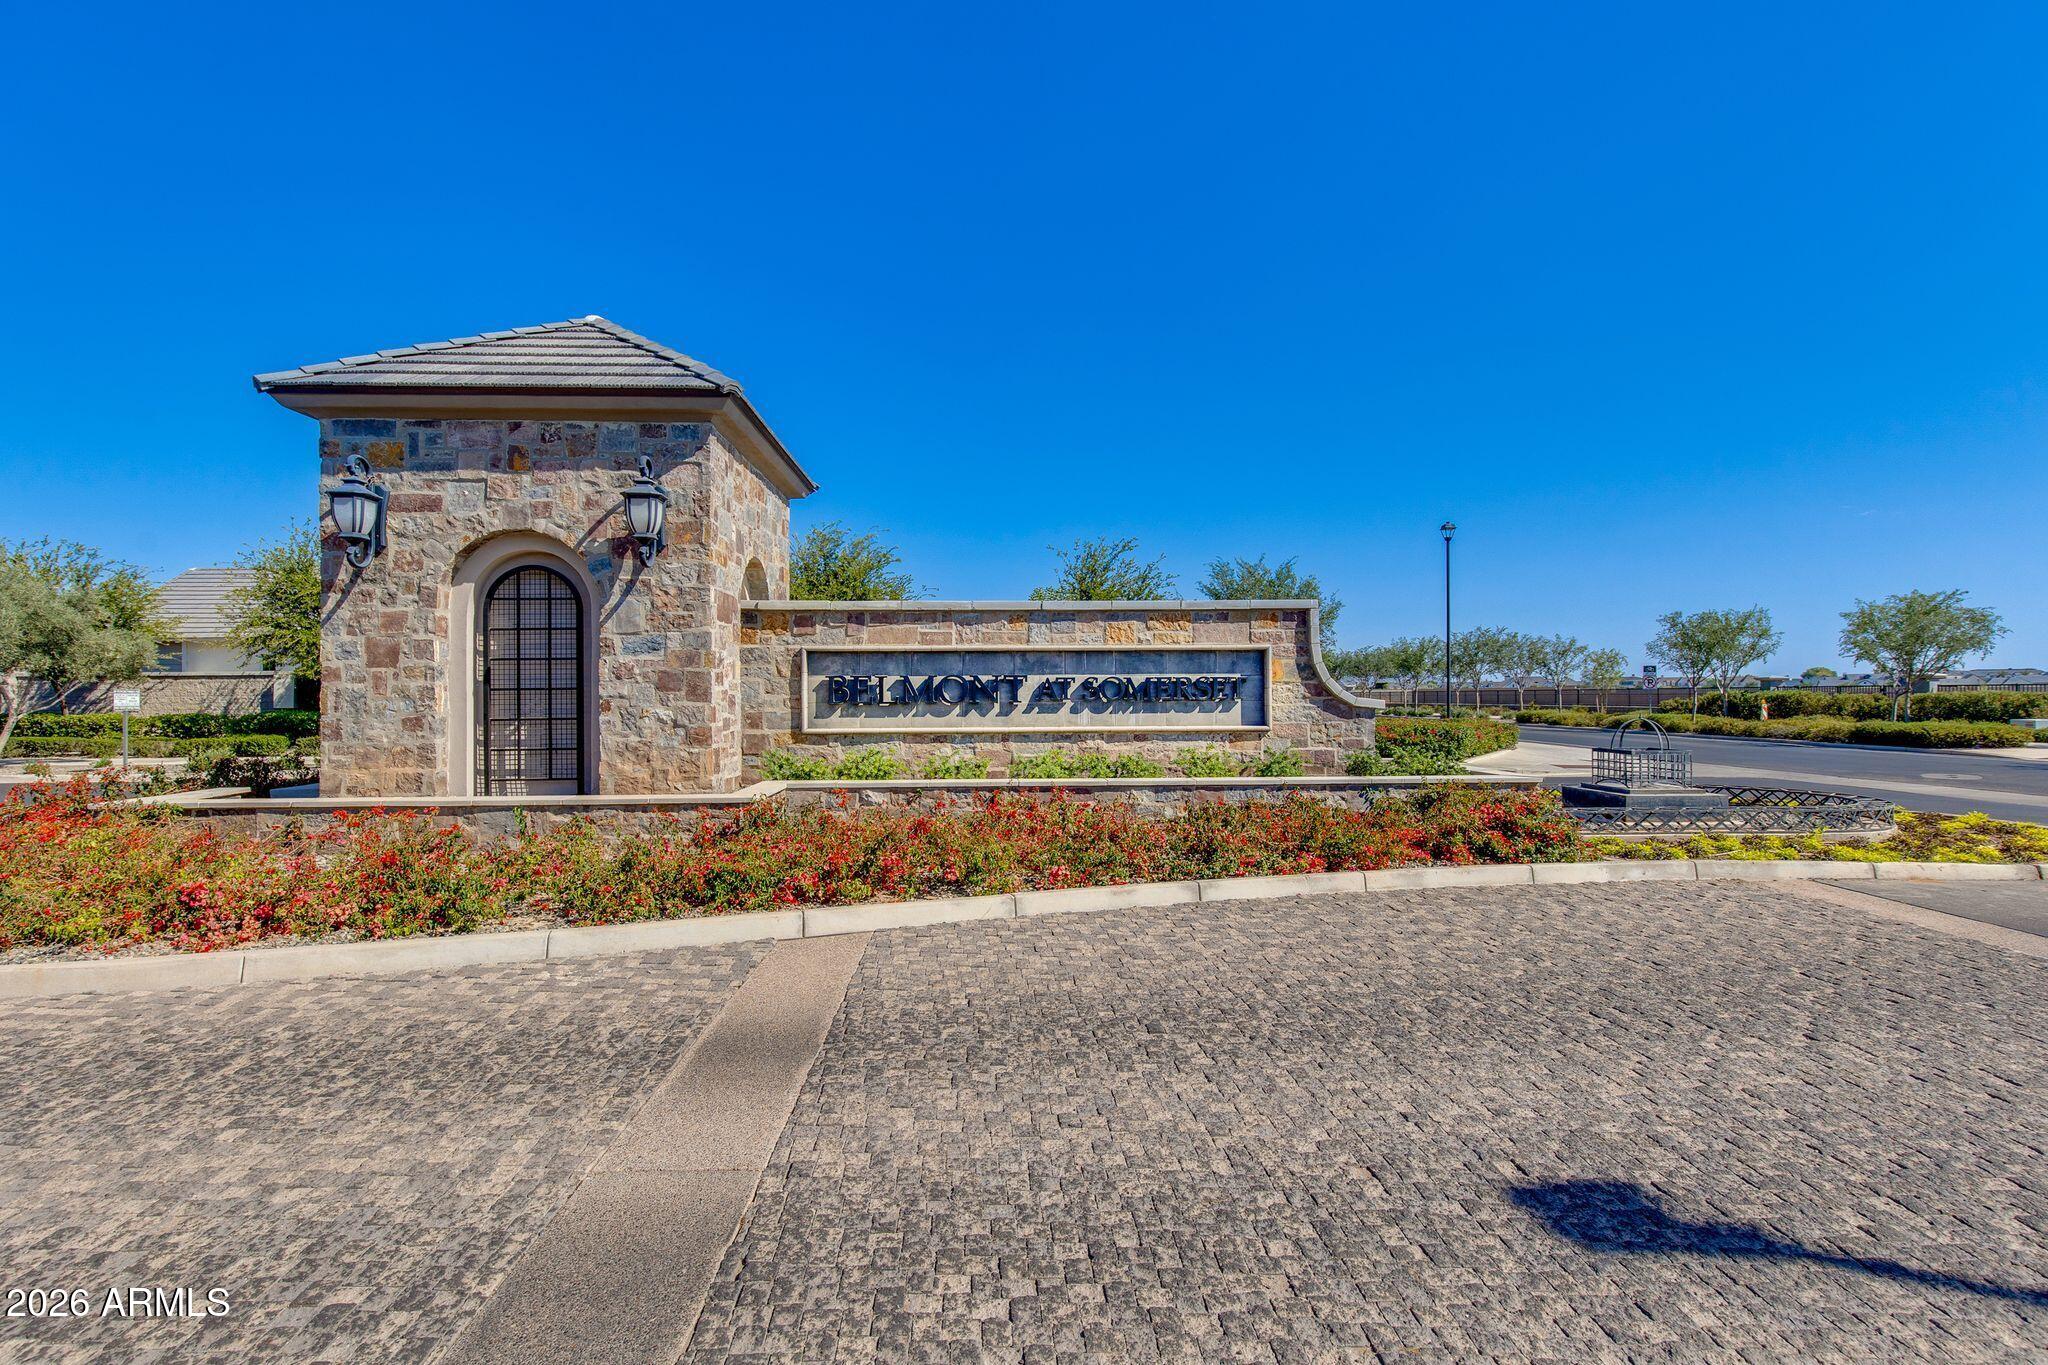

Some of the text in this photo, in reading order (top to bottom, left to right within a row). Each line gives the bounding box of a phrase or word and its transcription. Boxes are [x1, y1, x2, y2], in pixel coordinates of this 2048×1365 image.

[825, 675, 1248, 704] BELMONT AT SOMERSET
